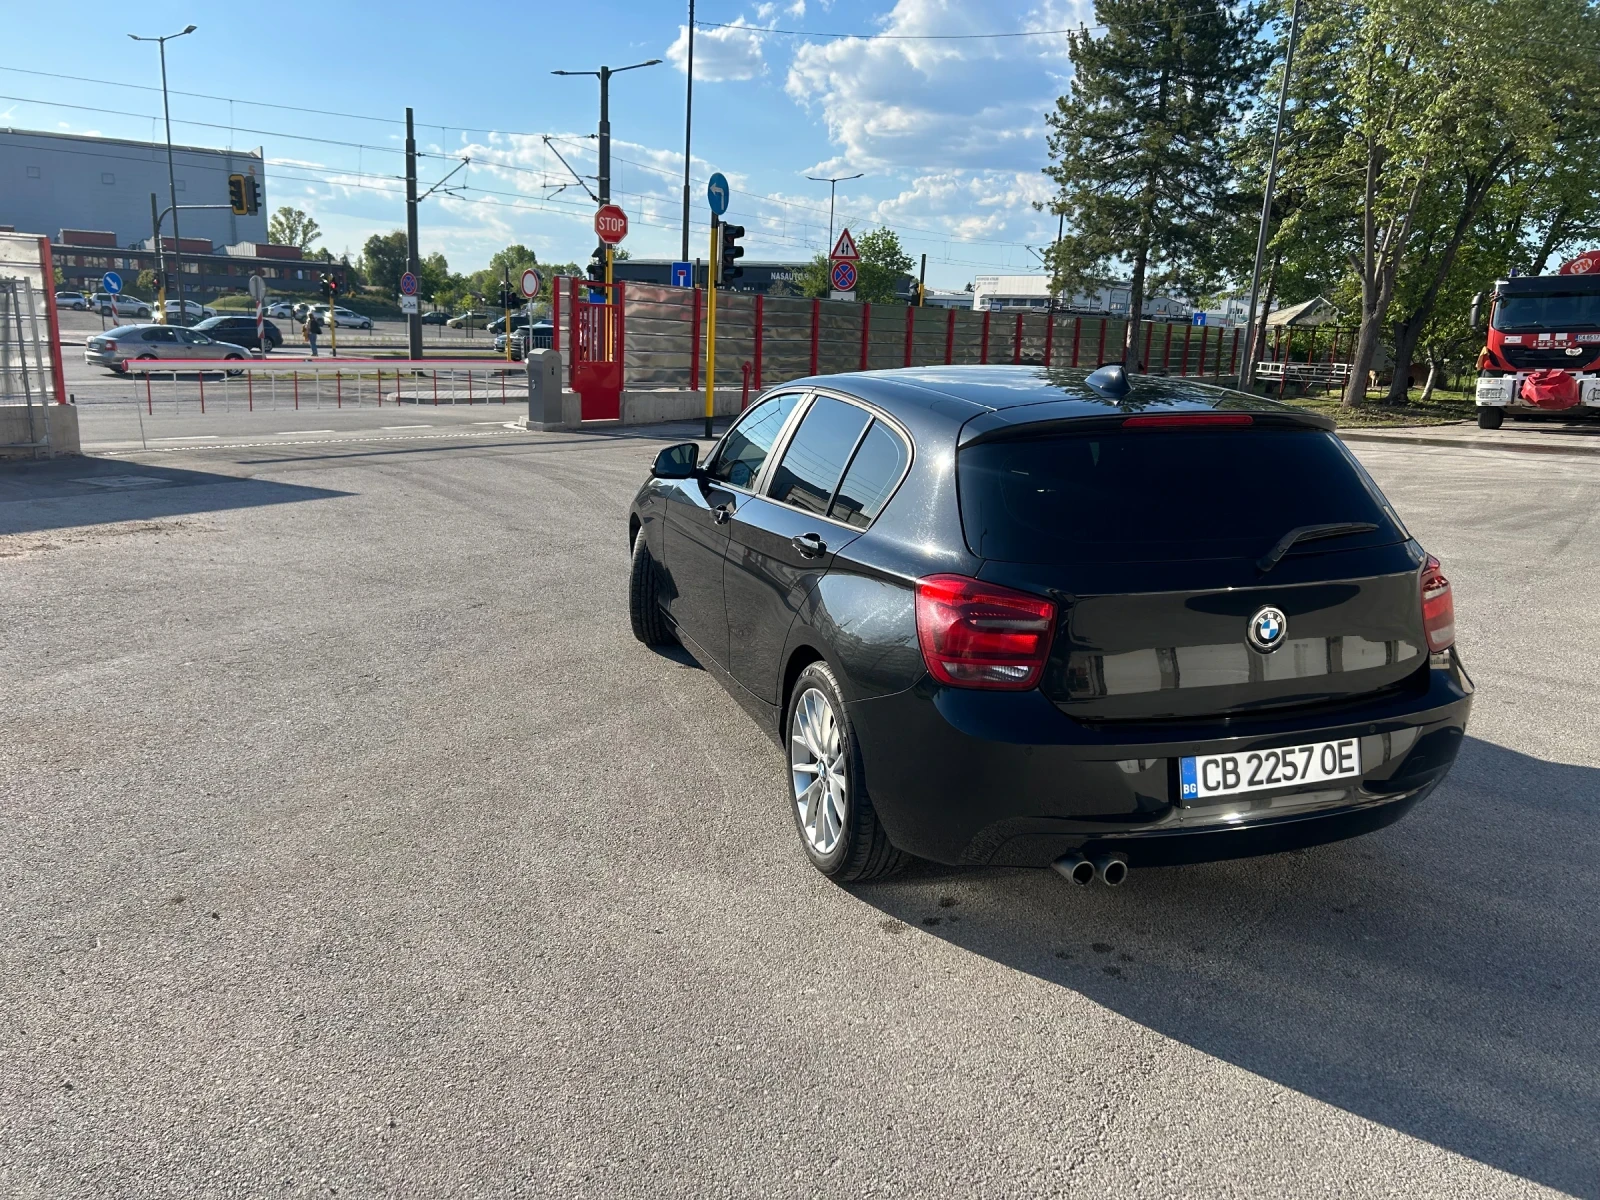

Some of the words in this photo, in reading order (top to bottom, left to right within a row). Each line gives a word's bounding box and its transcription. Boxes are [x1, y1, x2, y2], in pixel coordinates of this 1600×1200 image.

[598, 216, 625, 232] STOP
[770, 271, 804, 281] NASAUTO
[1202, 757, 1240, 792] CB
[1246, 746, 1314, 786] 2257
[1183, 783, 1197, 794] BG
